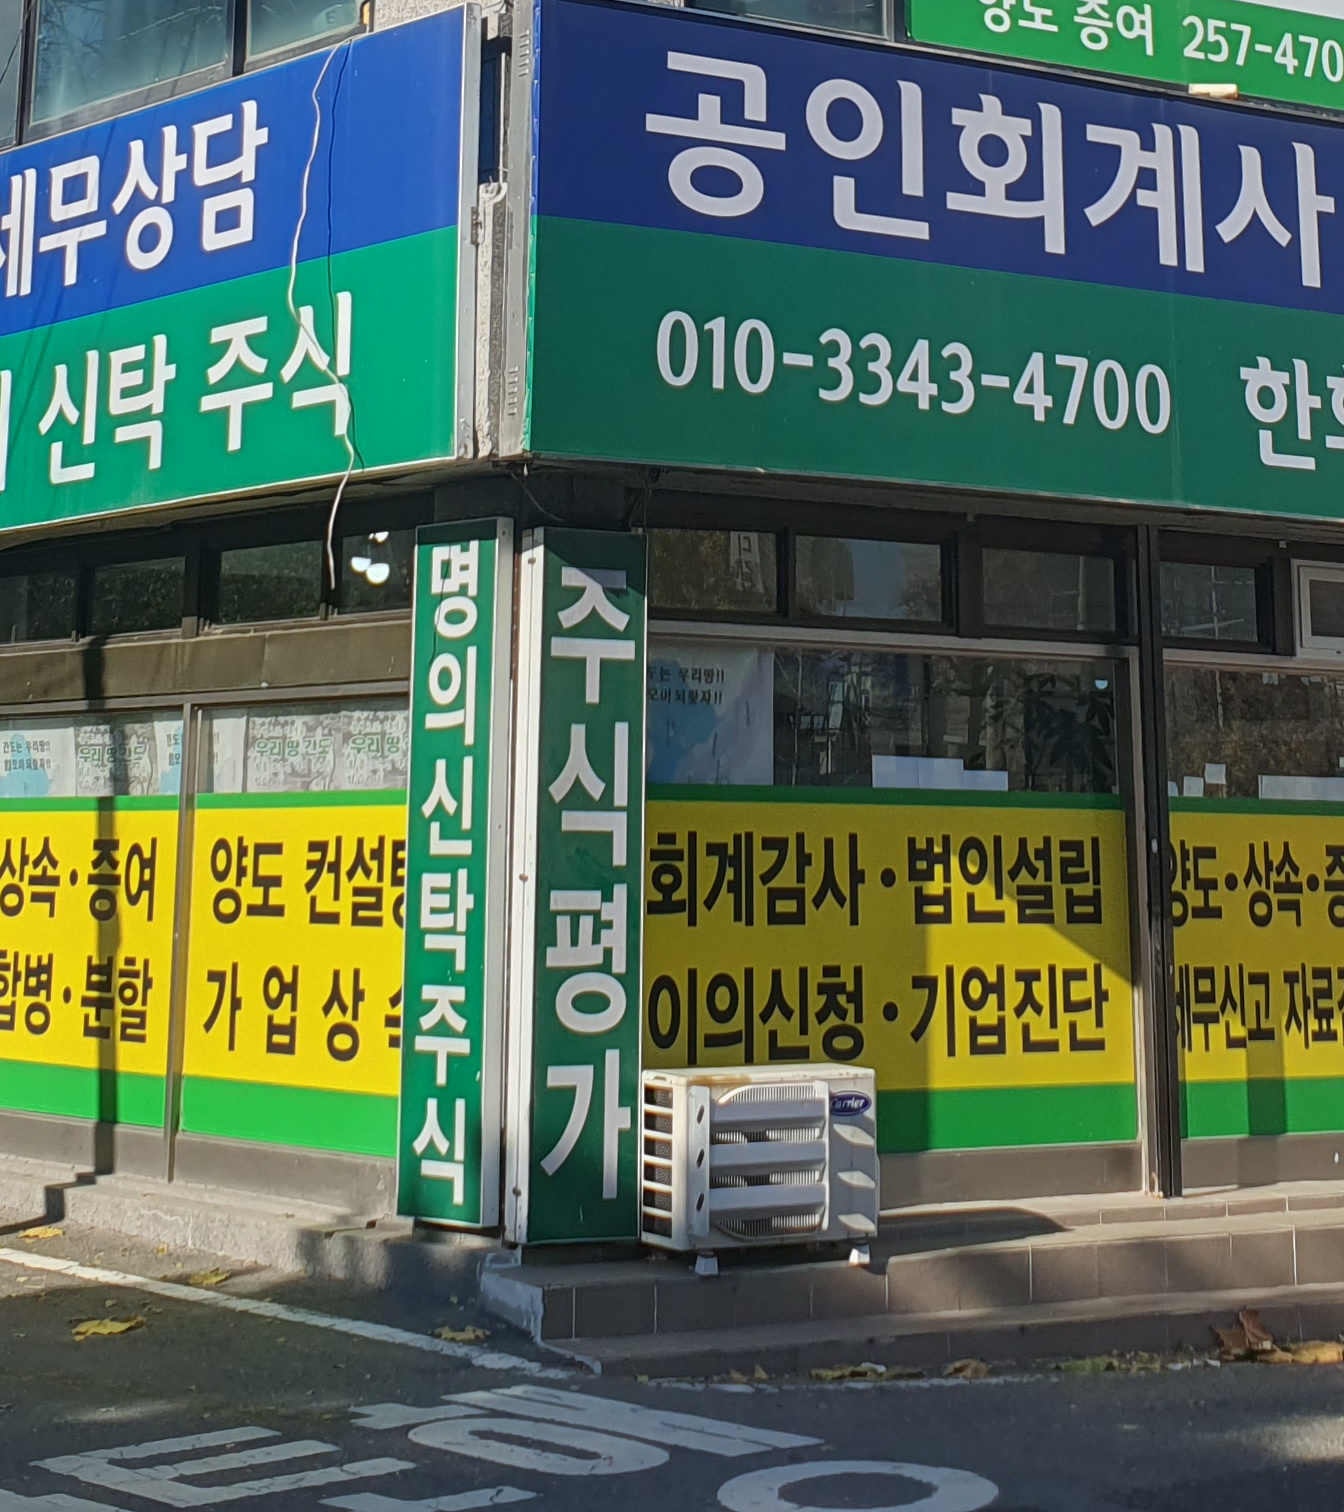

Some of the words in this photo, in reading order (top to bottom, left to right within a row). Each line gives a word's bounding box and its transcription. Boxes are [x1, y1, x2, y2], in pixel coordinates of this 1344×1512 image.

[38, 333, 176, 486] 신탁
[200, 292, 354, 454] 주식
[657, 310, 1172, 435] 010-3343-4700
[256, 739, 282, 758] 우리
[287, 739, 300, 758] 땅
[304, 737, 332, 757] 간도
[350, 734, 380, 755] 우리
[386, 735, 401, 755] 땅
[210, 835, 285, 925] 양도
[411, 543, 479, 1206] 명의신탁주식
[541, 568, 638, 1201] 주식평가
[831, 1097, 865, 1109] Carrier
